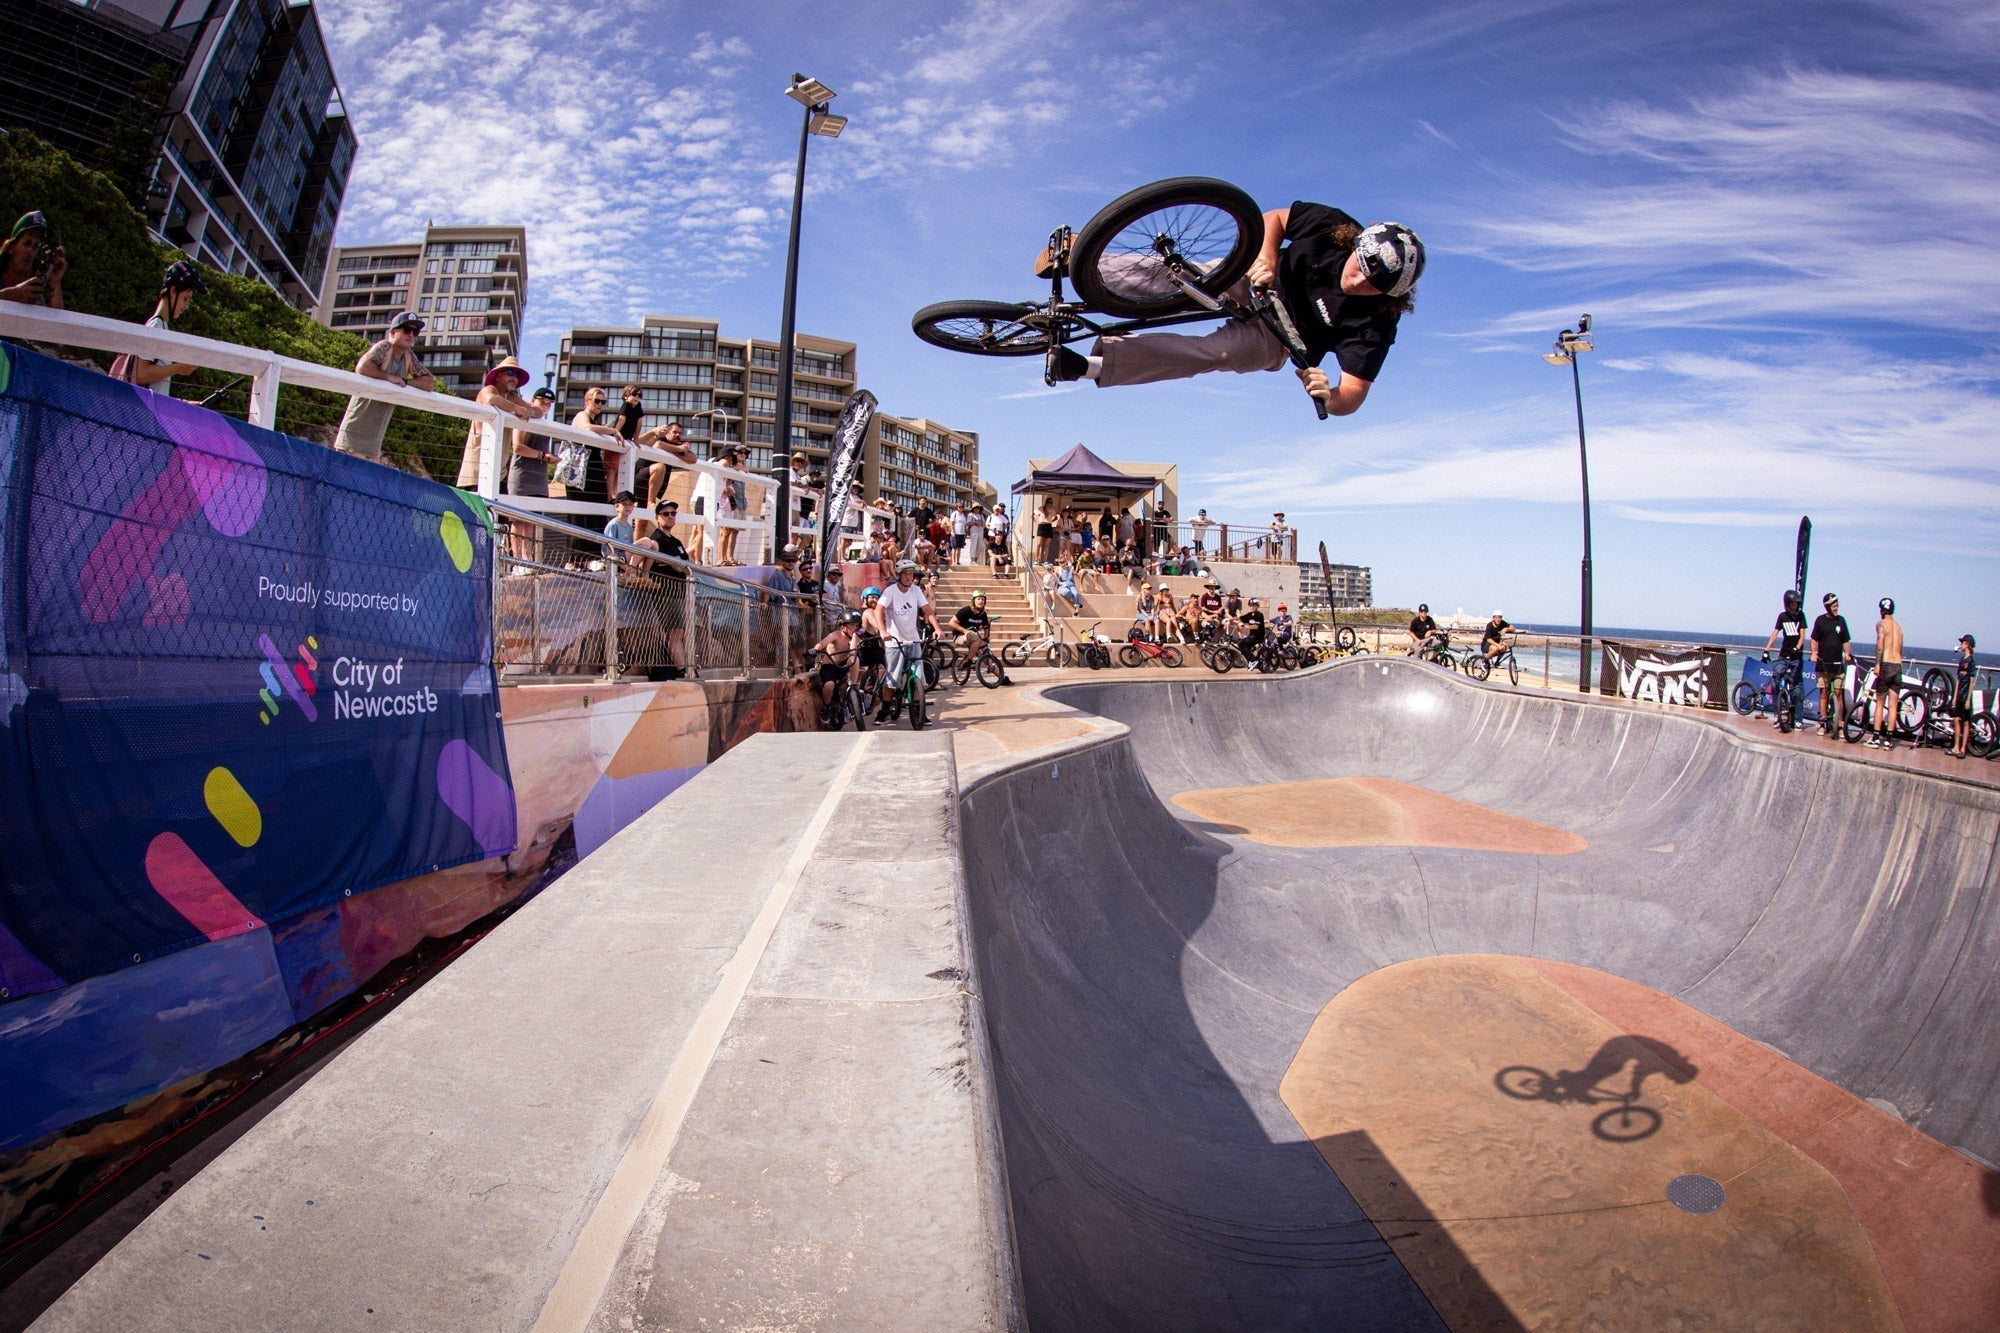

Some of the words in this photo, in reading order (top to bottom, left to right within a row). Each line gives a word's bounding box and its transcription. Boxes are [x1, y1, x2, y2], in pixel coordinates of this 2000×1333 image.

[258, 576, 321, 609] Proudly
[324, 589, 399, 612] supported
[402, 594, 418, 616] by
[332, 657, 378, 692] City
[382, 657, 403, 685] of
[1607, 645, 1712, 706] VANS
[1759, 668, 1774, 677] Prou
[334, 686, 438, 720] Newcastle
